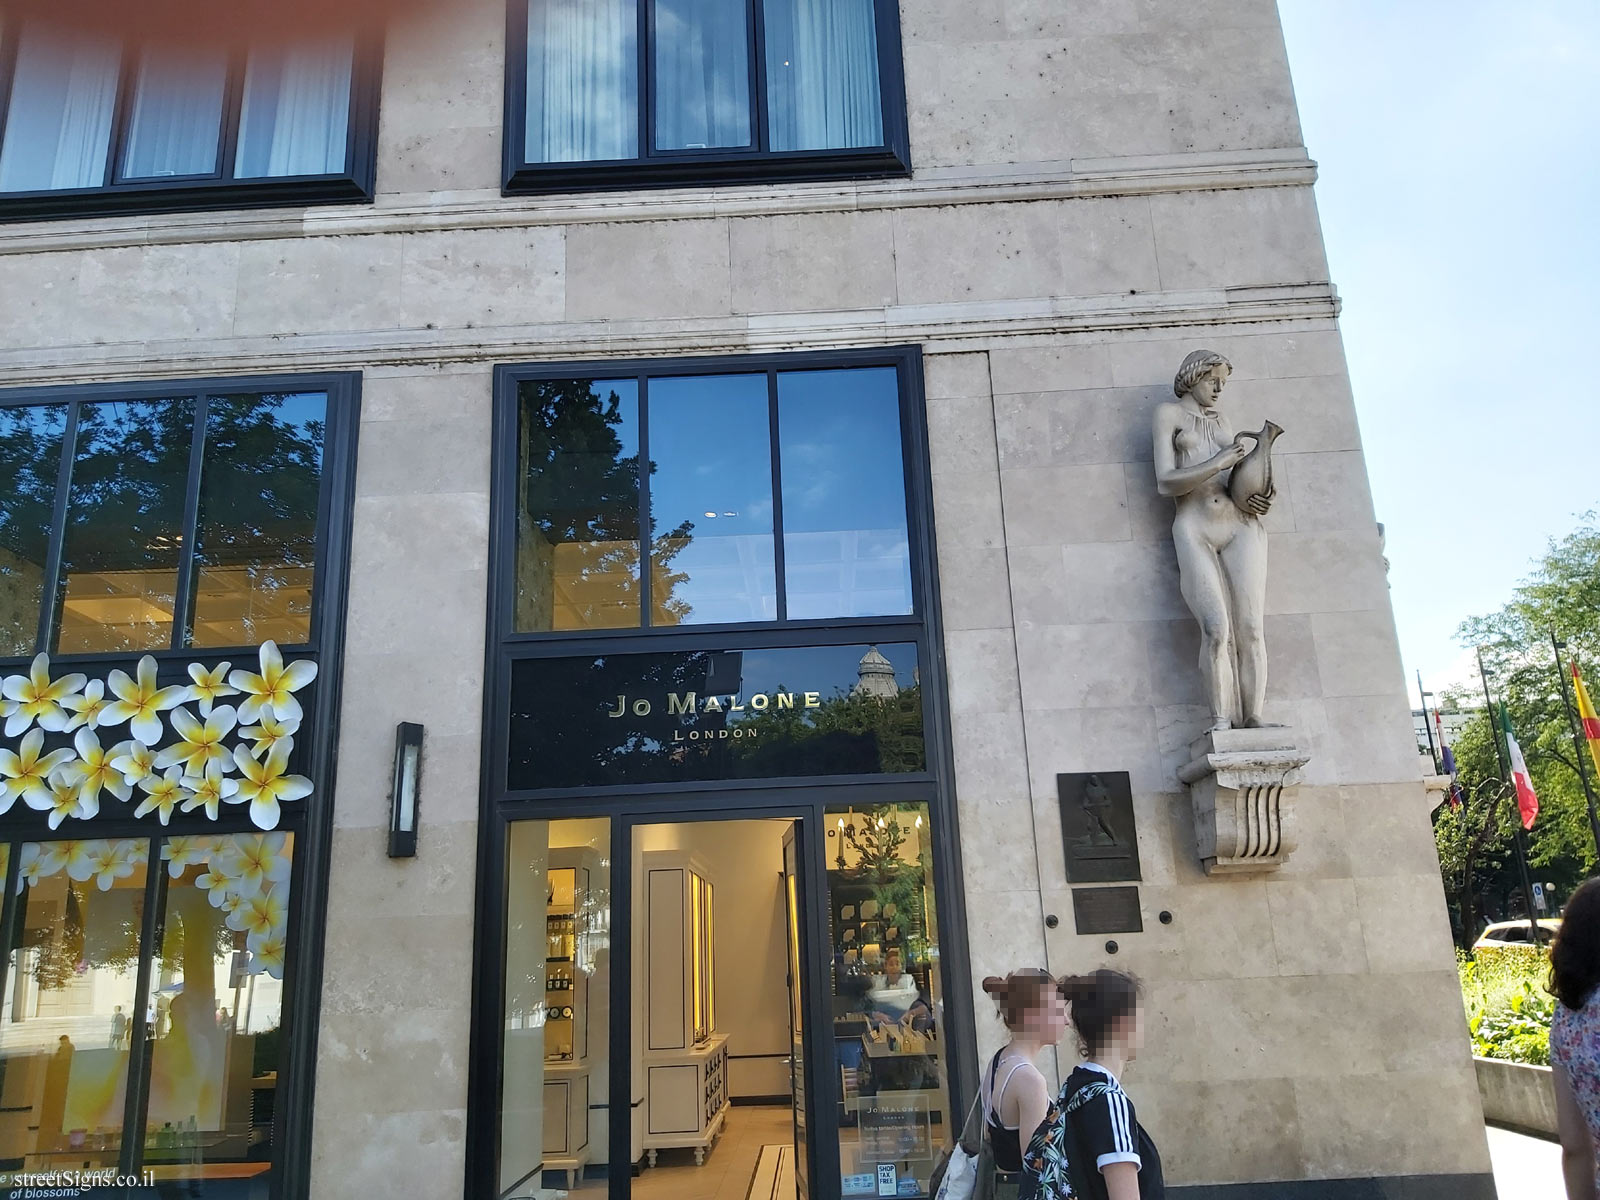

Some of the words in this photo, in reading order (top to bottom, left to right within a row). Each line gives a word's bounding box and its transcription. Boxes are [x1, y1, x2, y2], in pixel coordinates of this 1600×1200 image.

[667, 691, 821, 715] MALONE
[674, 728, 758, 741] LONDON
[84, 1167, 116, 1179] world
[10, 1188, 23, 1200] of
[25, 1187, 81, 1199] blossoms
